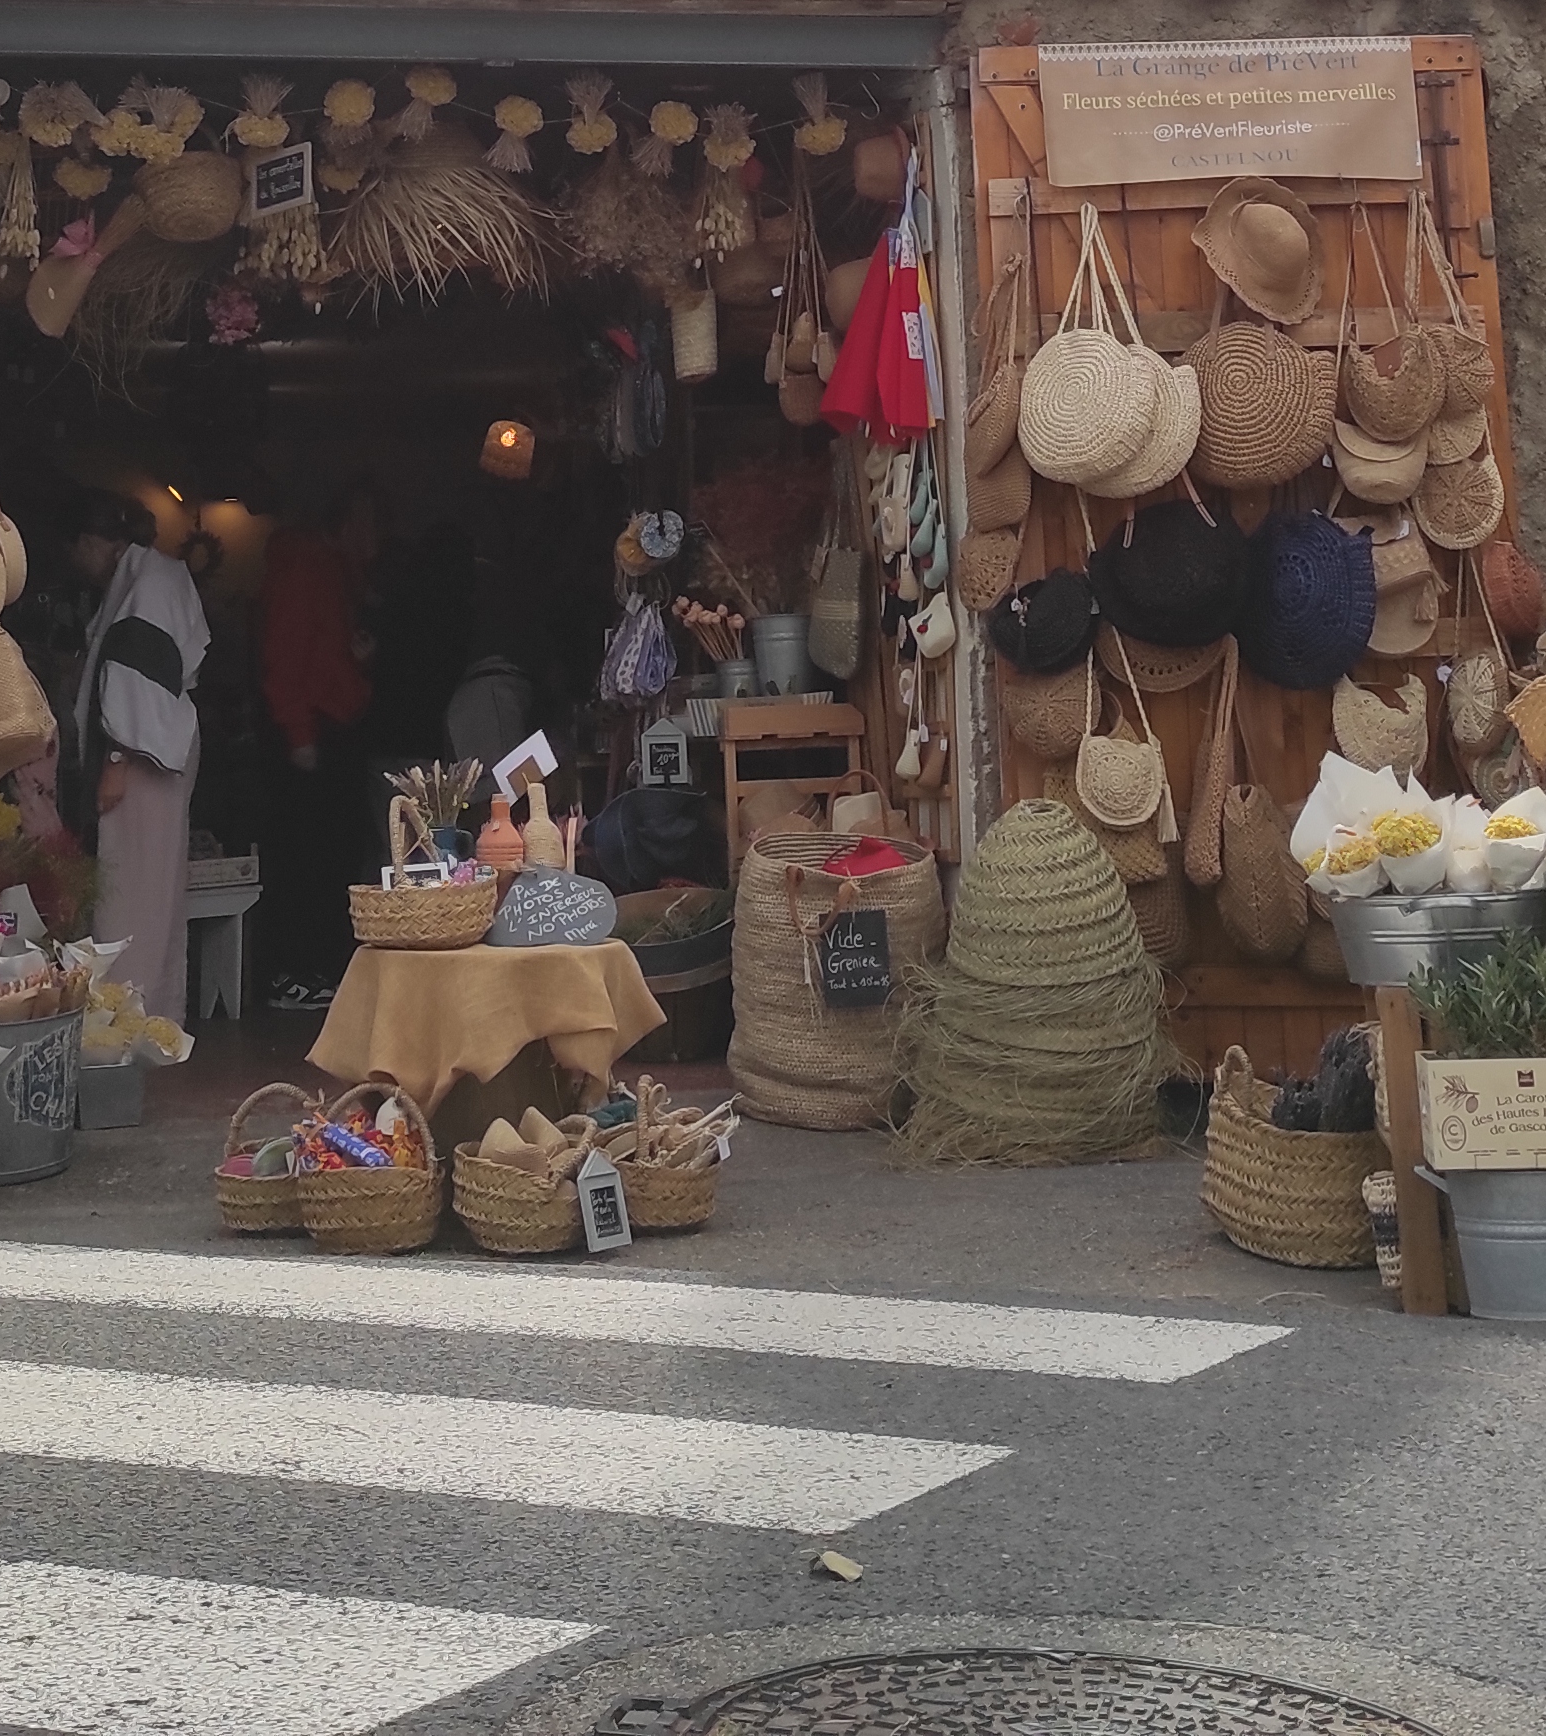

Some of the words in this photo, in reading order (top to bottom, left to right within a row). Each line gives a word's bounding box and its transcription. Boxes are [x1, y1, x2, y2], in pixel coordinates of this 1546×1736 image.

[1131, 57, 1221, 81] Grange
[1229, 55, 1258, 75] de
[1062, 91, 1122, 111] Fleurs
[1126, 88, 1202, 109] séchées
[1206, 90, 1225, 106] et
[1229, 86, 1293, 109] petites
[1298, 81, 1397, 104] merveilles
[1153, 119, 1313, 142] @PréVertFleuriste
[1171, 147, 1301, 168] CASTELNOU
[538, 876, 562, 892] DE
[498, 888, 565, 921] PHOTOS
[569, 881, 584, 892] A
[528, 922, 555, 942] NO
[551, 896, 607, 926] PHOTOS
[827, 977, 847, 990] Tout
[1496, 1095, 1513, 1107] La
[1471, 1113, 1494, 1128] des
[1496, 1107, 1540, 1121] Hautes
[1489, 1124, 1507, 1136] de
